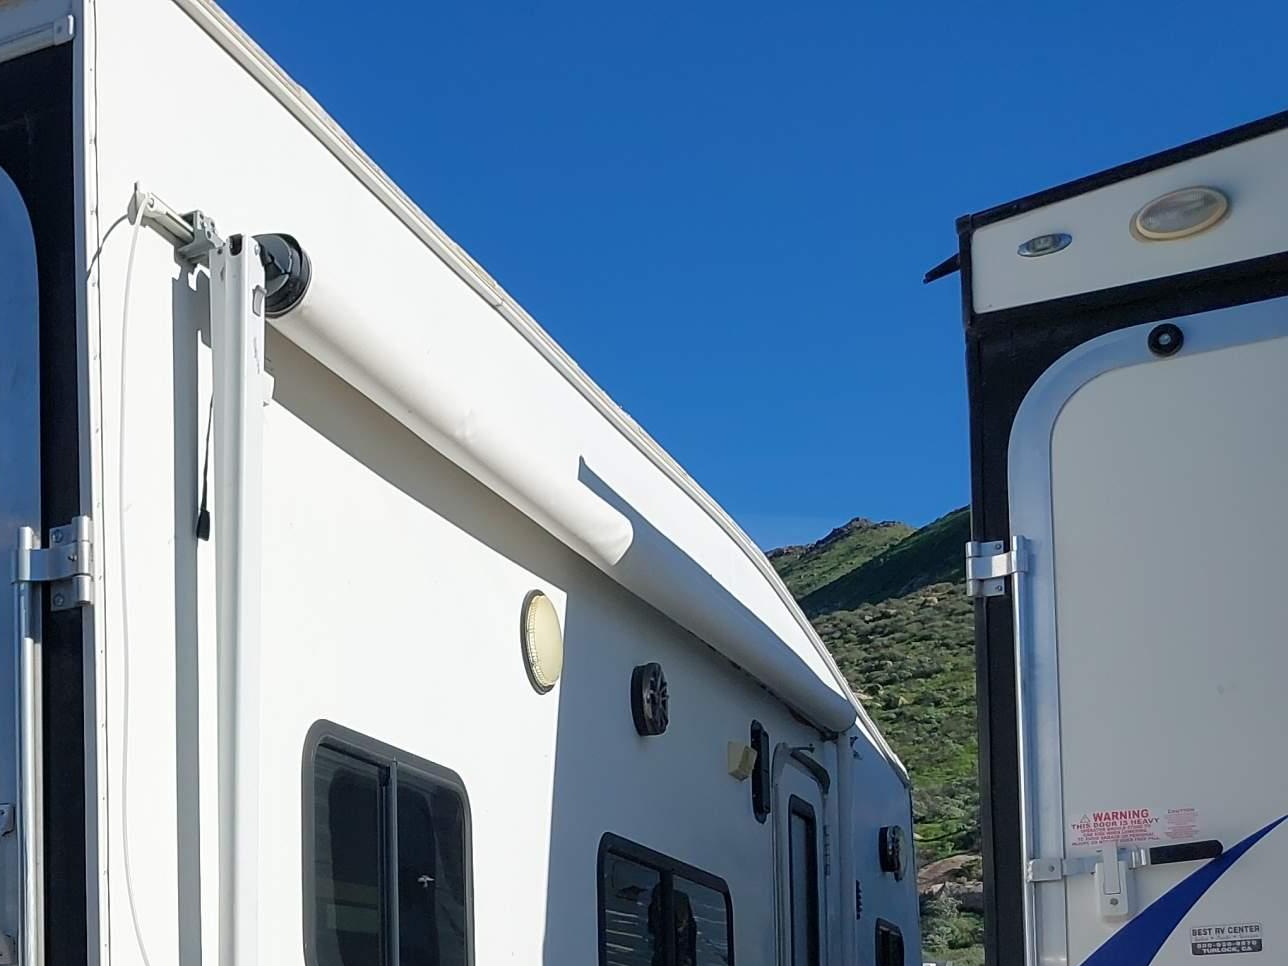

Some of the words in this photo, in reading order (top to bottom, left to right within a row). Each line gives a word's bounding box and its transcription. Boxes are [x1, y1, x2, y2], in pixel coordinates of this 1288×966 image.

[1093, 809, 1149, 822] WARNING
[1093, 820, 1117, 828] DOOR
[1131, 817, 1160, 825] HEAVY
[1192, 928, 1212, 936] BEST
[1228, 925, 1260, 934] CENTER
